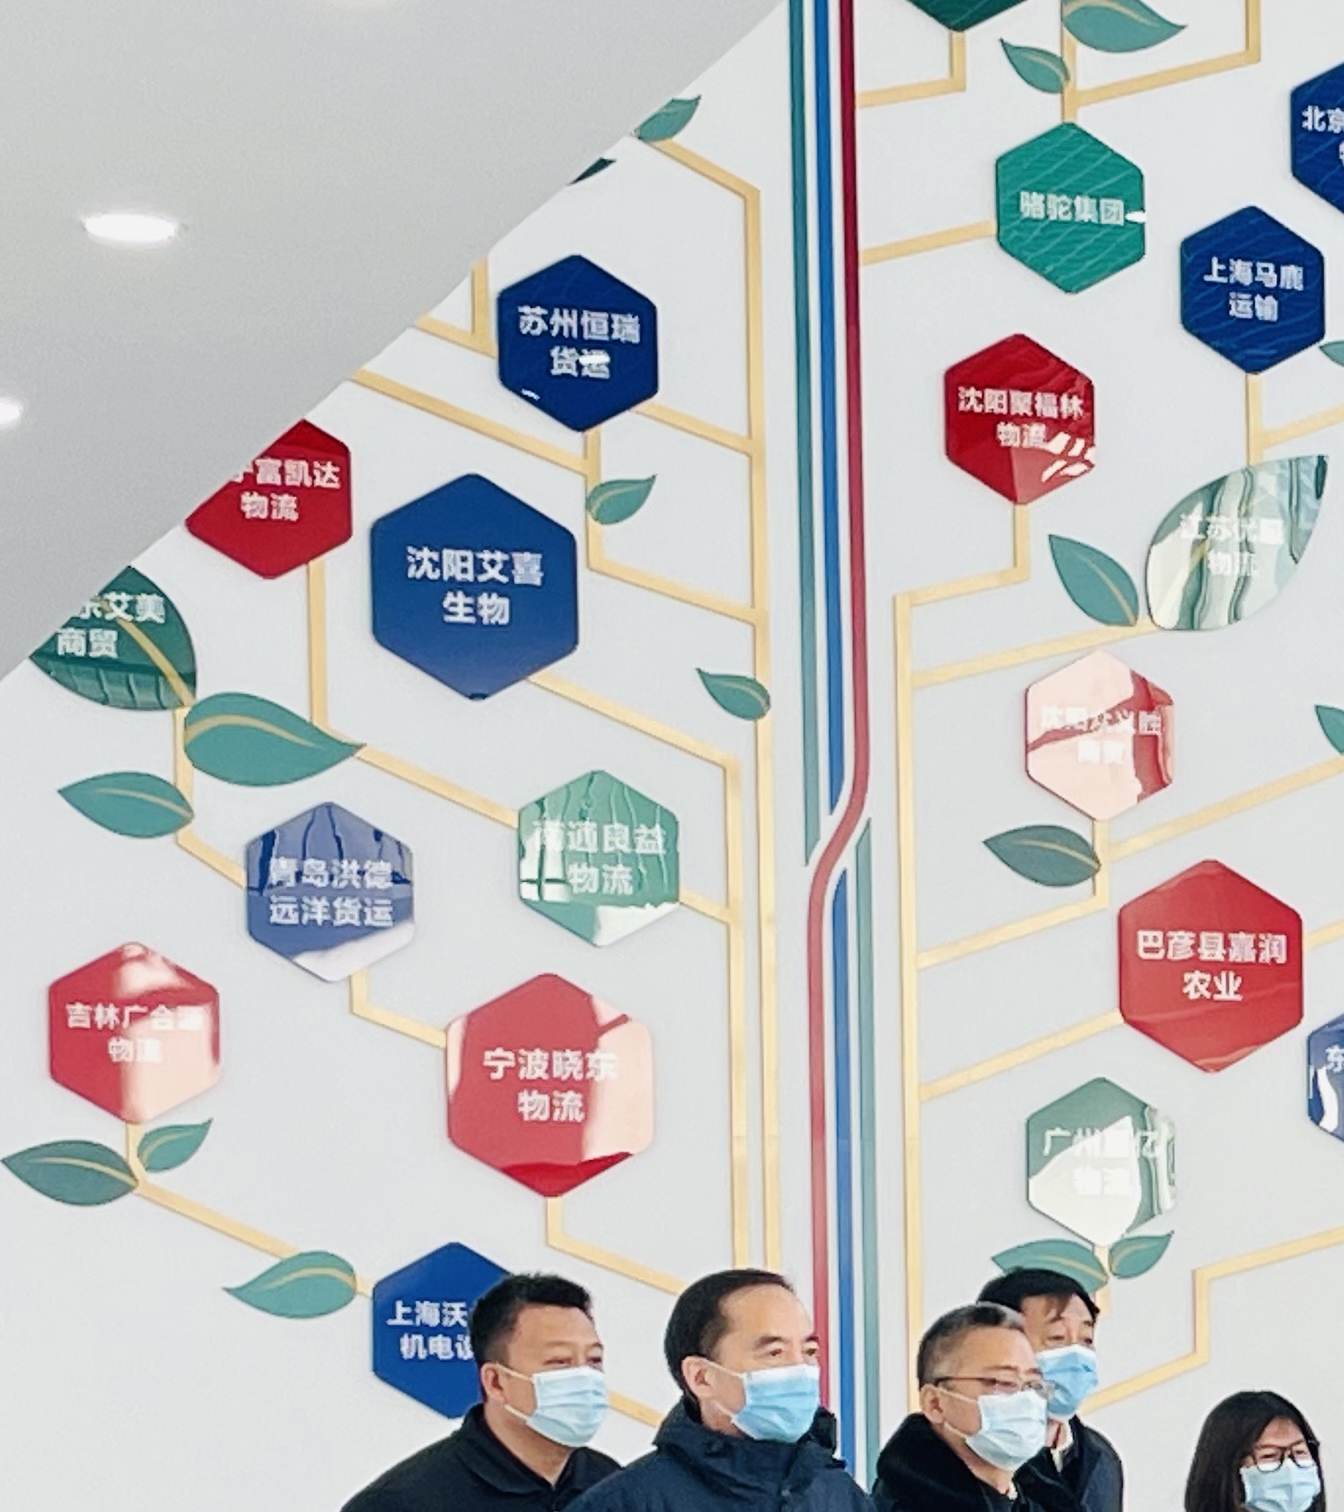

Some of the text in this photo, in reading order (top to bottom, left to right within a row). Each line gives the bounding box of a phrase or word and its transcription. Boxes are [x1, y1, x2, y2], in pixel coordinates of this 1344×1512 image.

[1020, 191, 1125, 226] 骆驼集团
[1229, 292, 1278, 322] 运输
[518, 305, 641, 344] 苏州恒瑞
[240, 491, 299, 521] 物流
[406, 545, 544, 587] 沈阳艾喜
[442, 590, 511, 625] 生物
[57, 627, 119, 658] 商贸
[270, 857, 393, 889] 青岛洪德
[568, 862, 634, 895] 物流
[270, 895, 393, 927] 远洋货运
[1137, 929, 1288, 965] 巴彦县嘉润
[1182, 970, 1244, 1002] 农业
[482, 1047, 618, 1082] 宁波晓东
[517, 1089, 585, 1122] 物流
